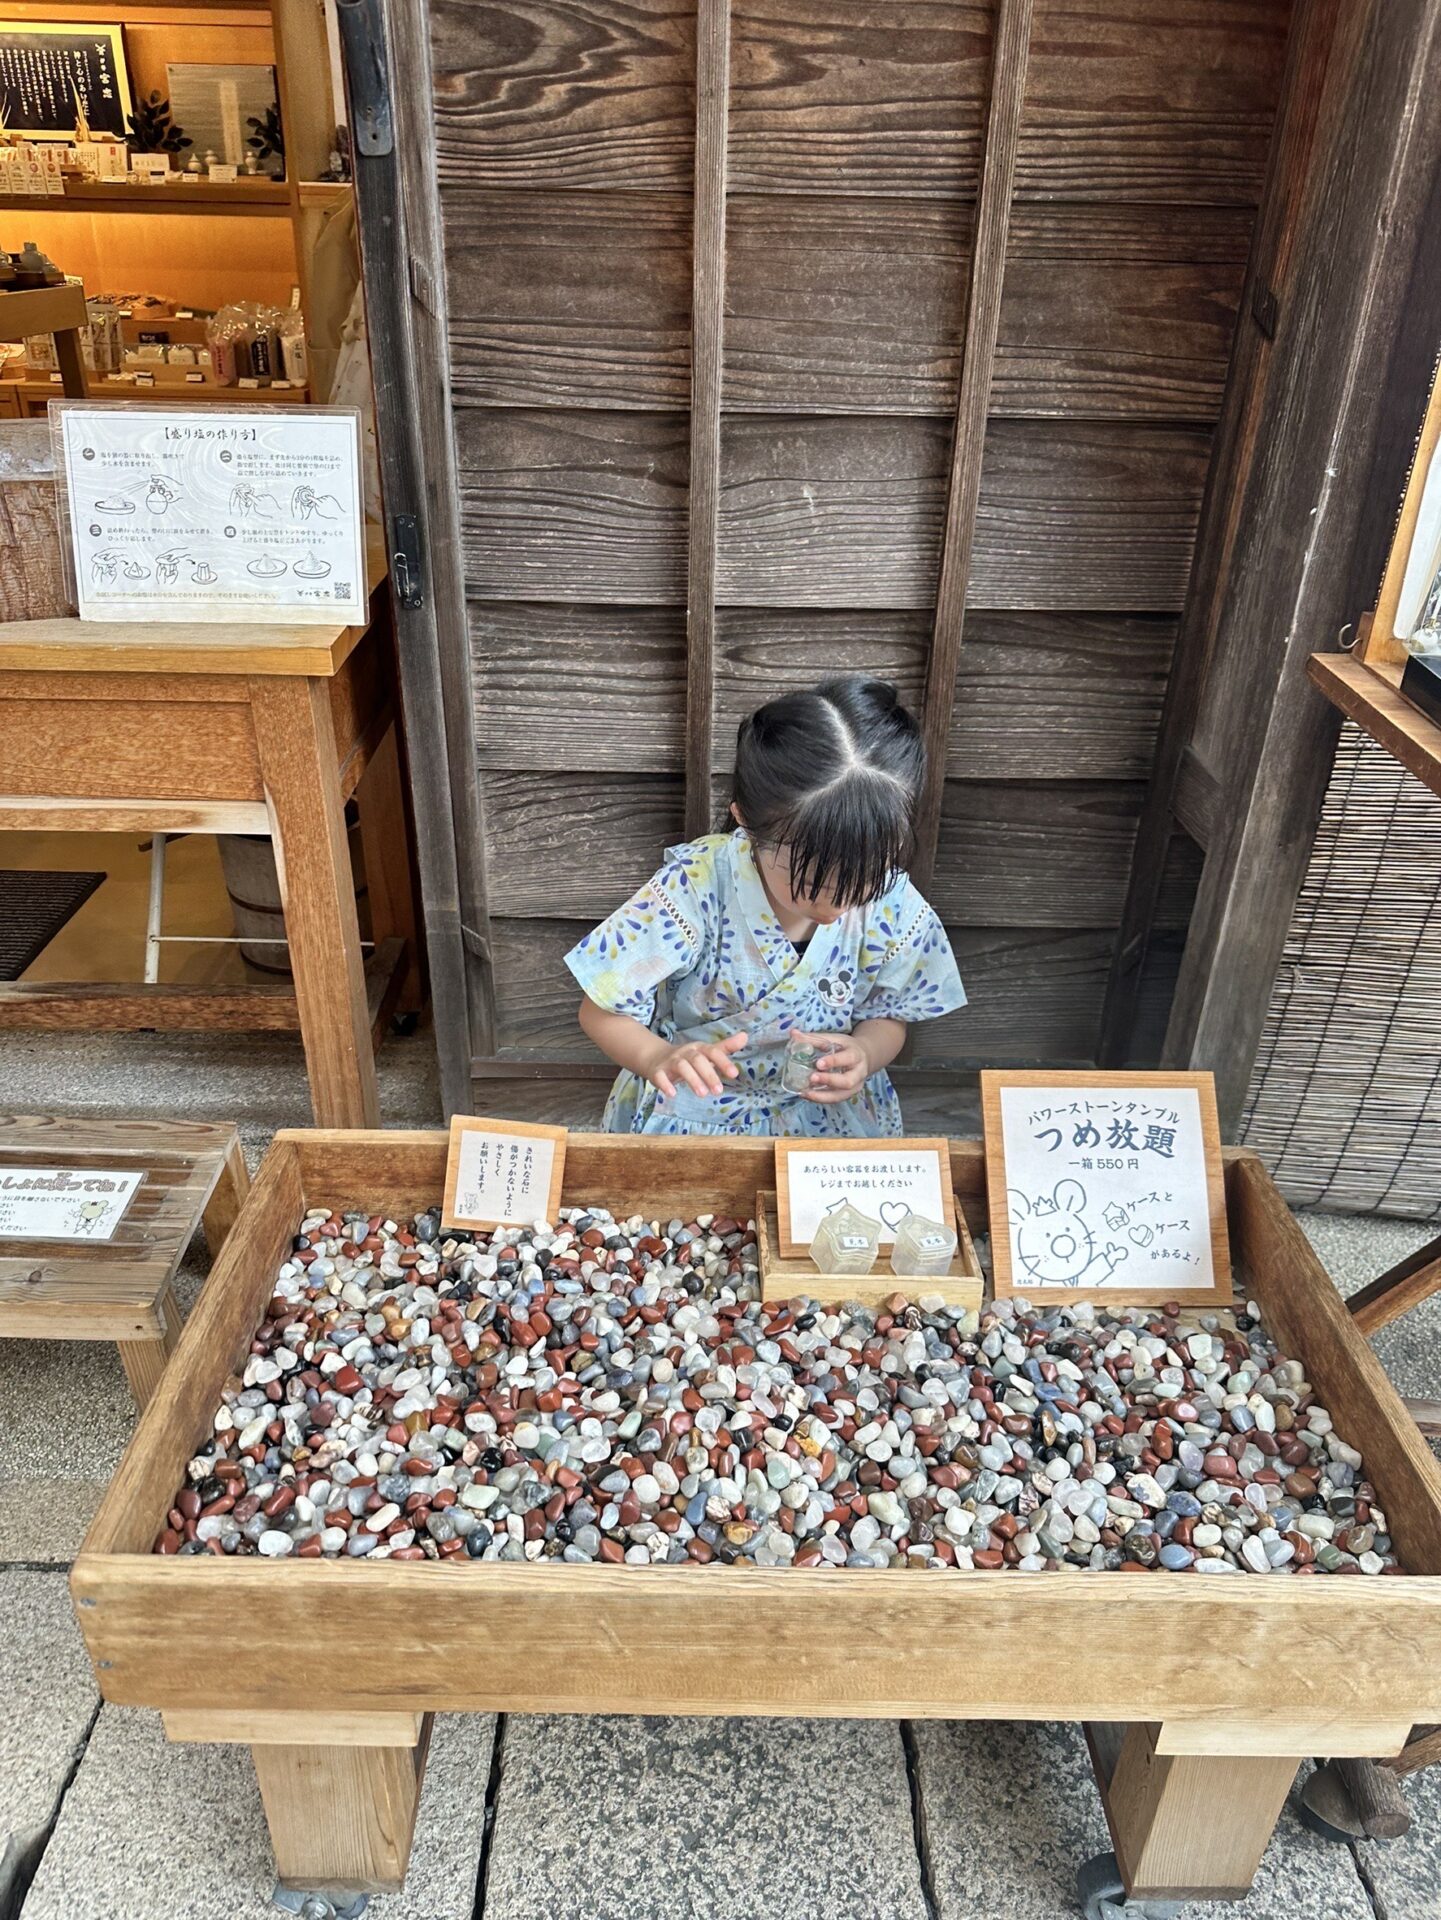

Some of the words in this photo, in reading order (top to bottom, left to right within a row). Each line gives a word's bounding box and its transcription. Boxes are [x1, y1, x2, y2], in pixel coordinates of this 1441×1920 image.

[164, 426, 256, 441] 【盛り塩の作り方】
[1027, 1100, 1180, 1125] パワーストーンタンブル
[1034, 1118, 1177, 1159] つめ放題
[478, 1141, 488, 1194] お願いします。
[494, 1143, 504, 1177] やさしく
[521, 1146, 533, 1194] きれいな石に
[803, 1163, 927, 1174] あたらしい容器をお渡しします。
[0, 1175, 129, 1192] しょに使ってね！
[504, 1144, 519, 1216] 傷がつかないように
[819, 1178, 913, 1189] レジまでお越しください
[1126, 1191, 1173, 1213] ケースと
[1155, 1220, 1191, 1235] ケース
